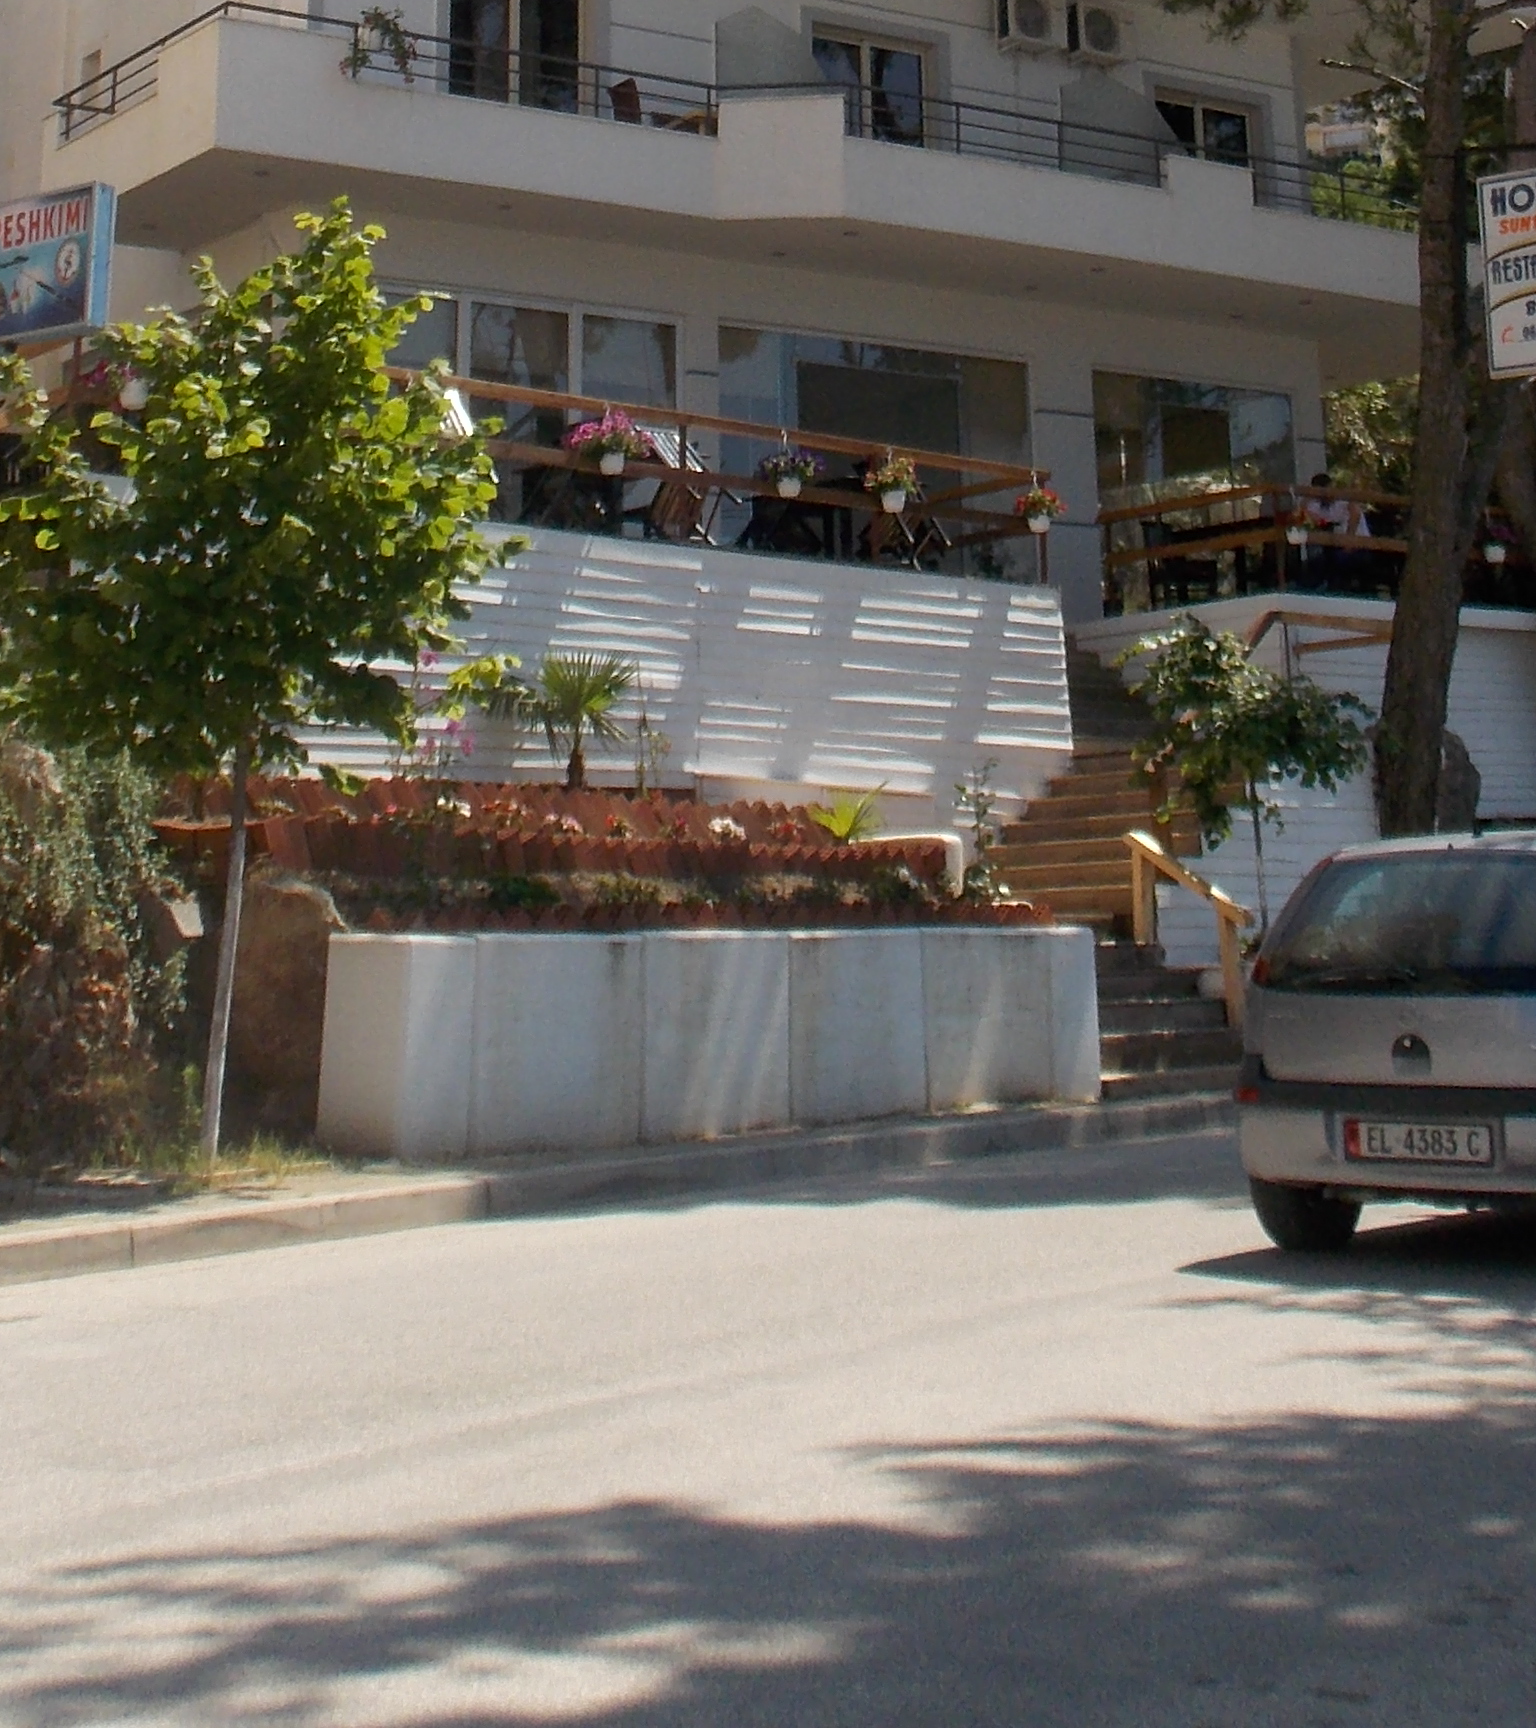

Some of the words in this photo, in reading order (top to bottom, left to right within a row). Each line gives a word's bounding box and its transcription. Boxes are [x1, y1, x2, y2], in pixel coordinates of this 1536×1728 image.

[1367, 1126, 1392, 1153] EL
[1404, 1128, 1457, 1155] 4383
[1467, 1131, 1479, 1156] C
